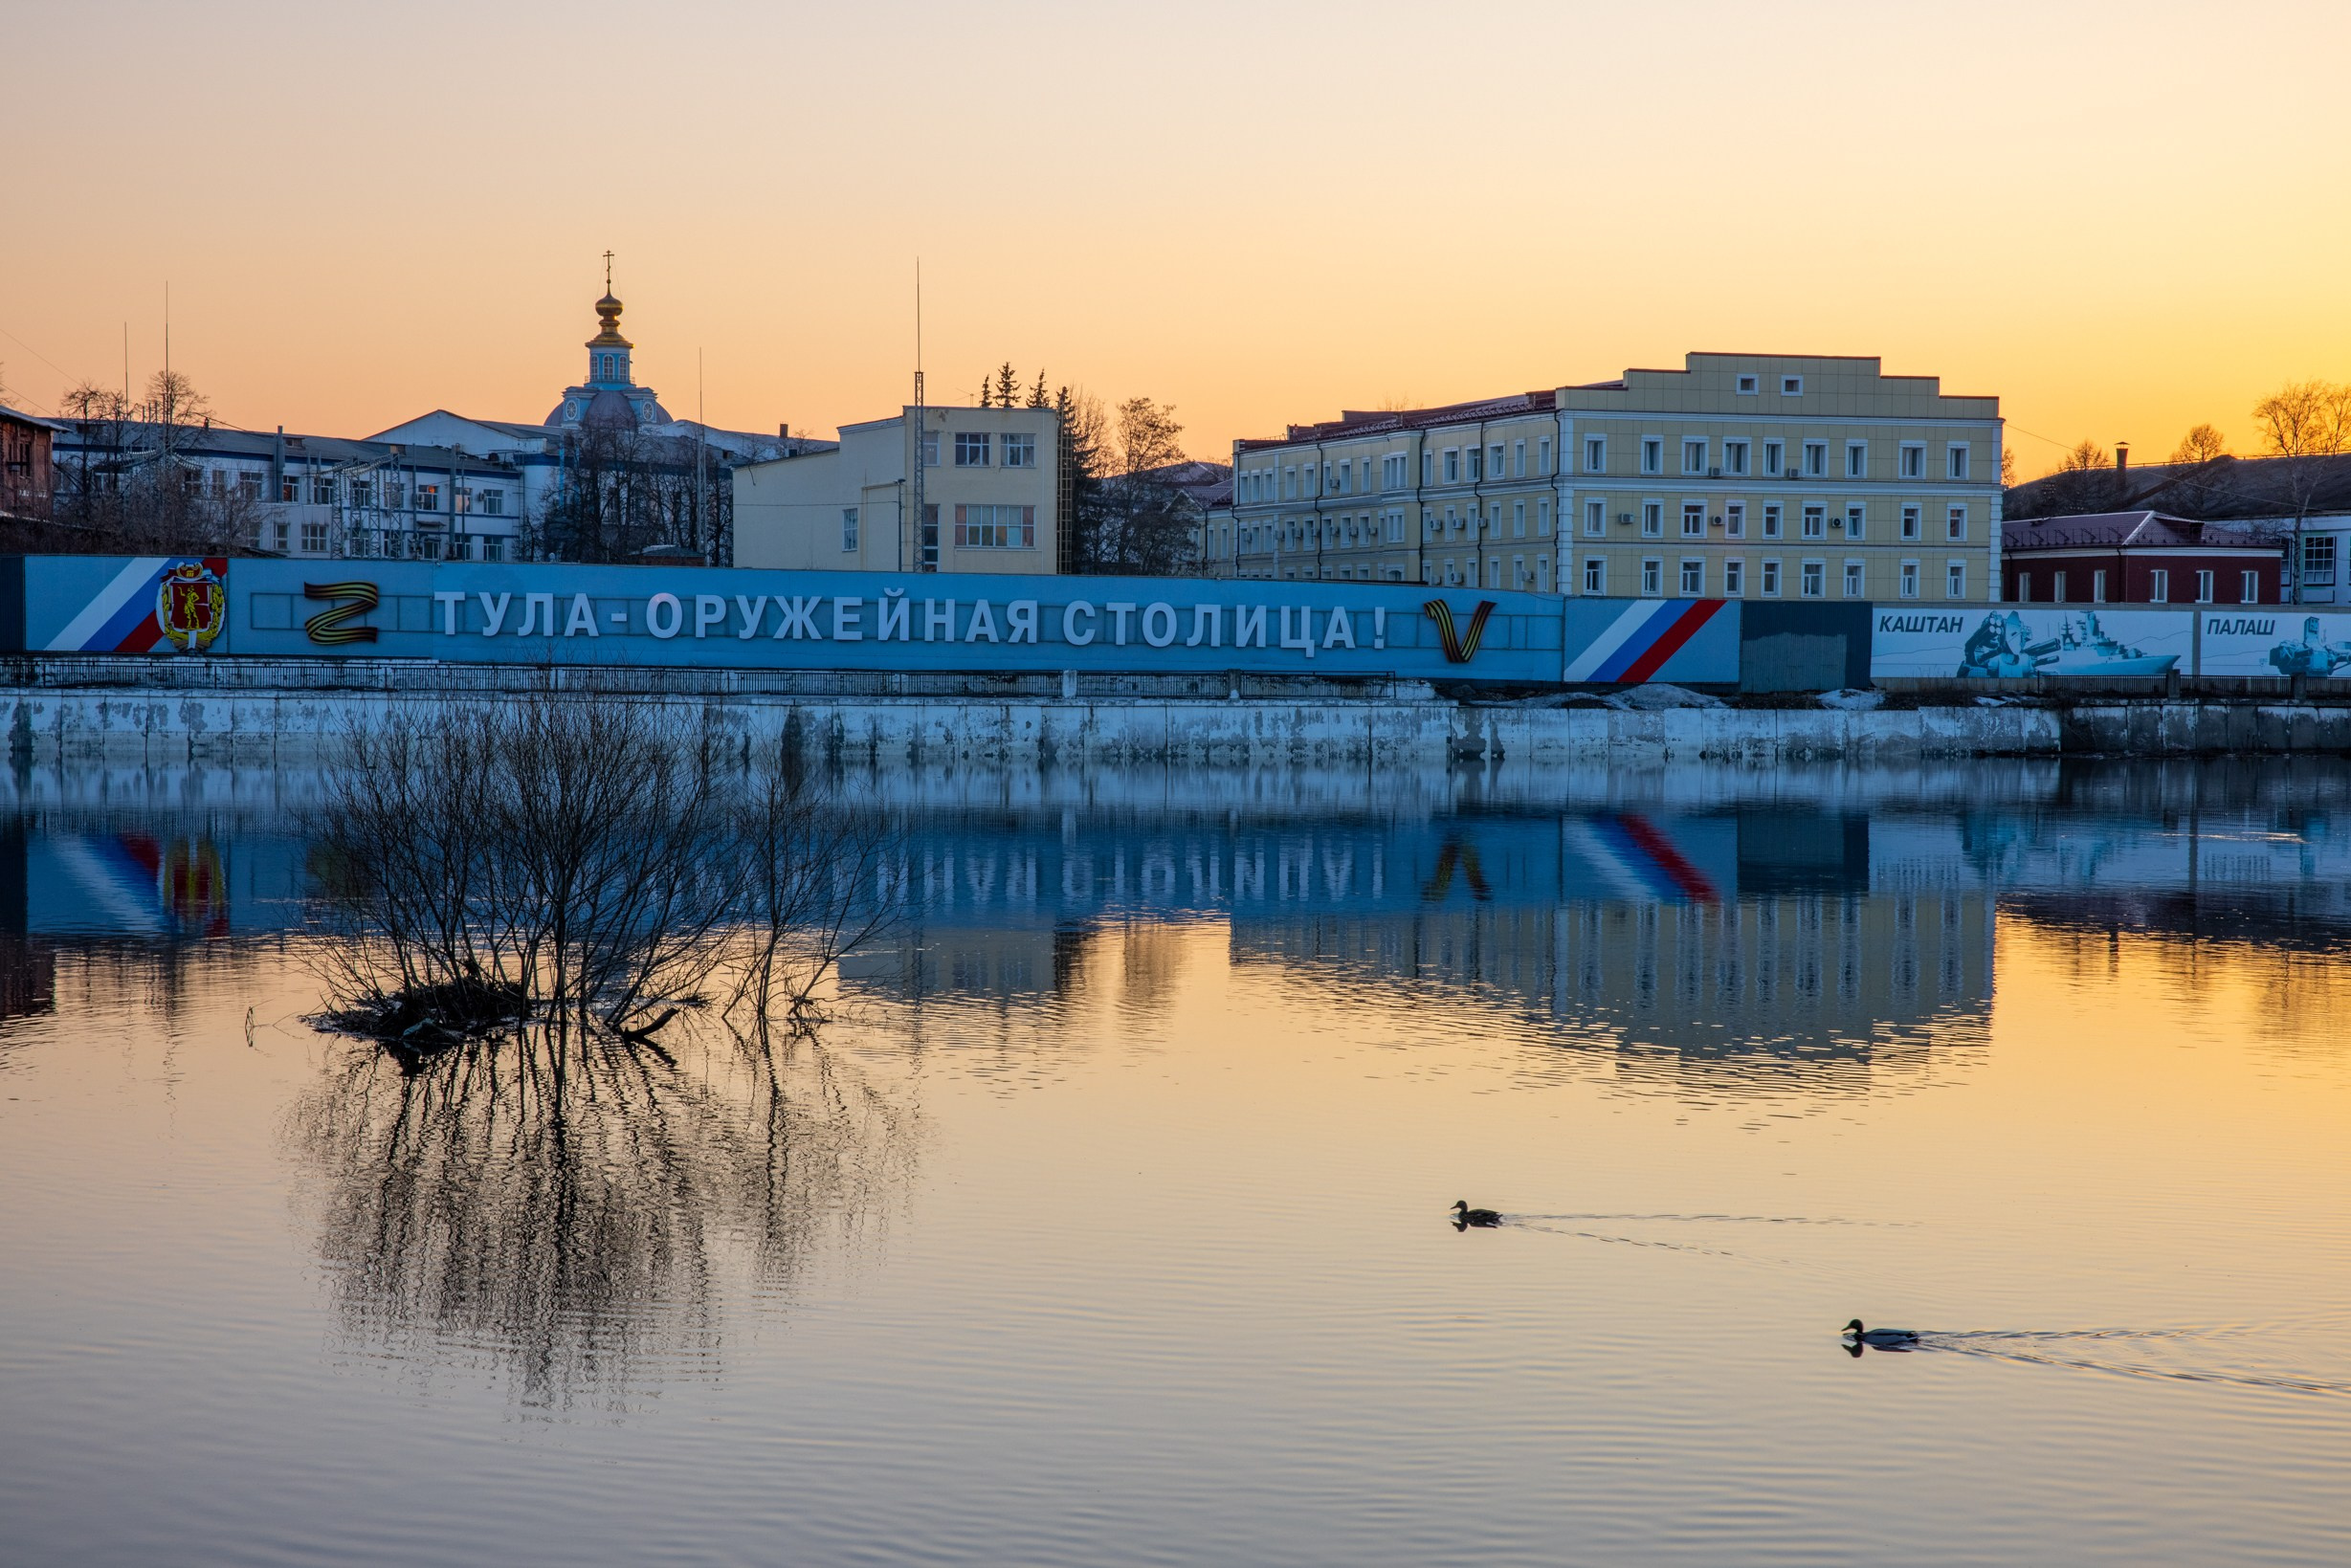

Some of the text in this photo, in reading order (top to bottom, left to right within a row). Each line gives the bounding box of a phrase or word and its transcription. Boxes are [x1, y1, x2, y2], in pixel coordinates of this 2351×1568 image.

[645, 586, 1038, 644] ОРУЖЕЙНАЯ
[1878, 615, 1963, 633] КАШТАН
[2207, 619, 2275, 635] ПАЛАШ
